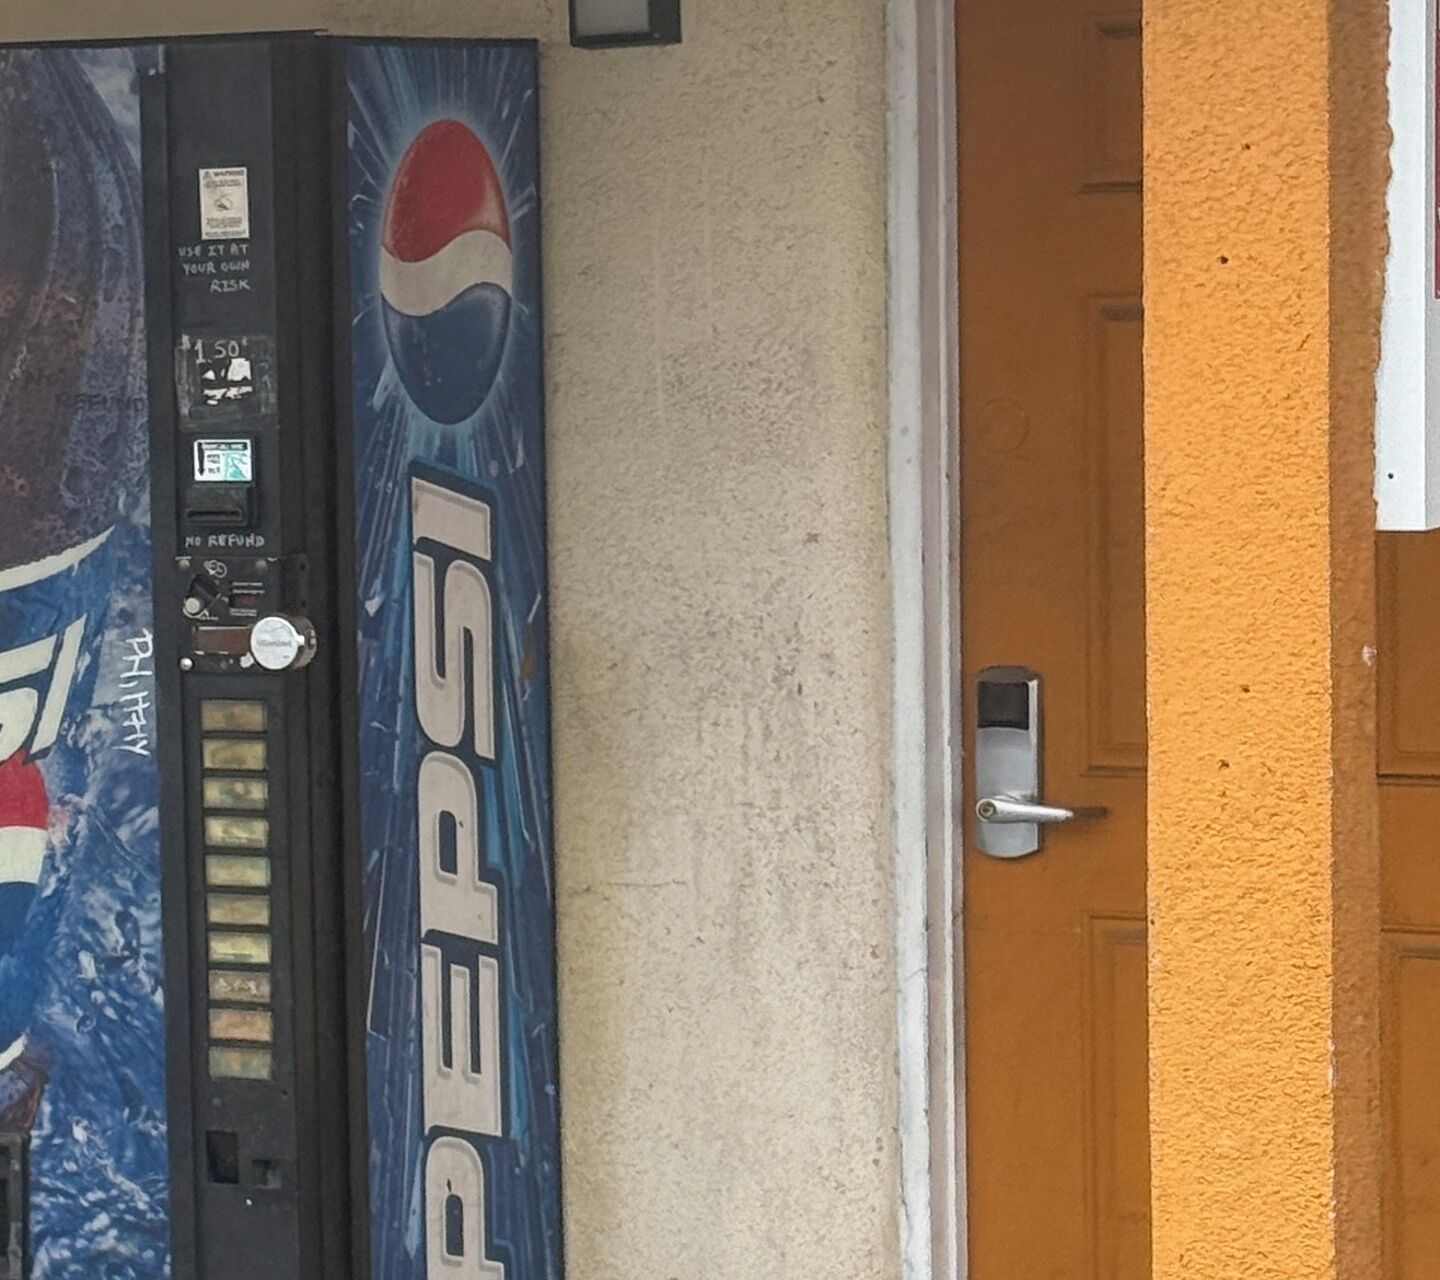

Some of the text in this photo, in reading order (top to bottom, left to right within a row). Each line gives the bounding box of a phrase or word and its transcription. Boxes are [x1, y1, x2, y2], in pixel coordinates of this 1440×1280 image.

[178, 242, 249, 257] USE IT AT
[182, 259, 251, 276] YOUR OWN
[209, 279, 251, 293] RISK
[184, 532, 266, 548] NO REFUND
